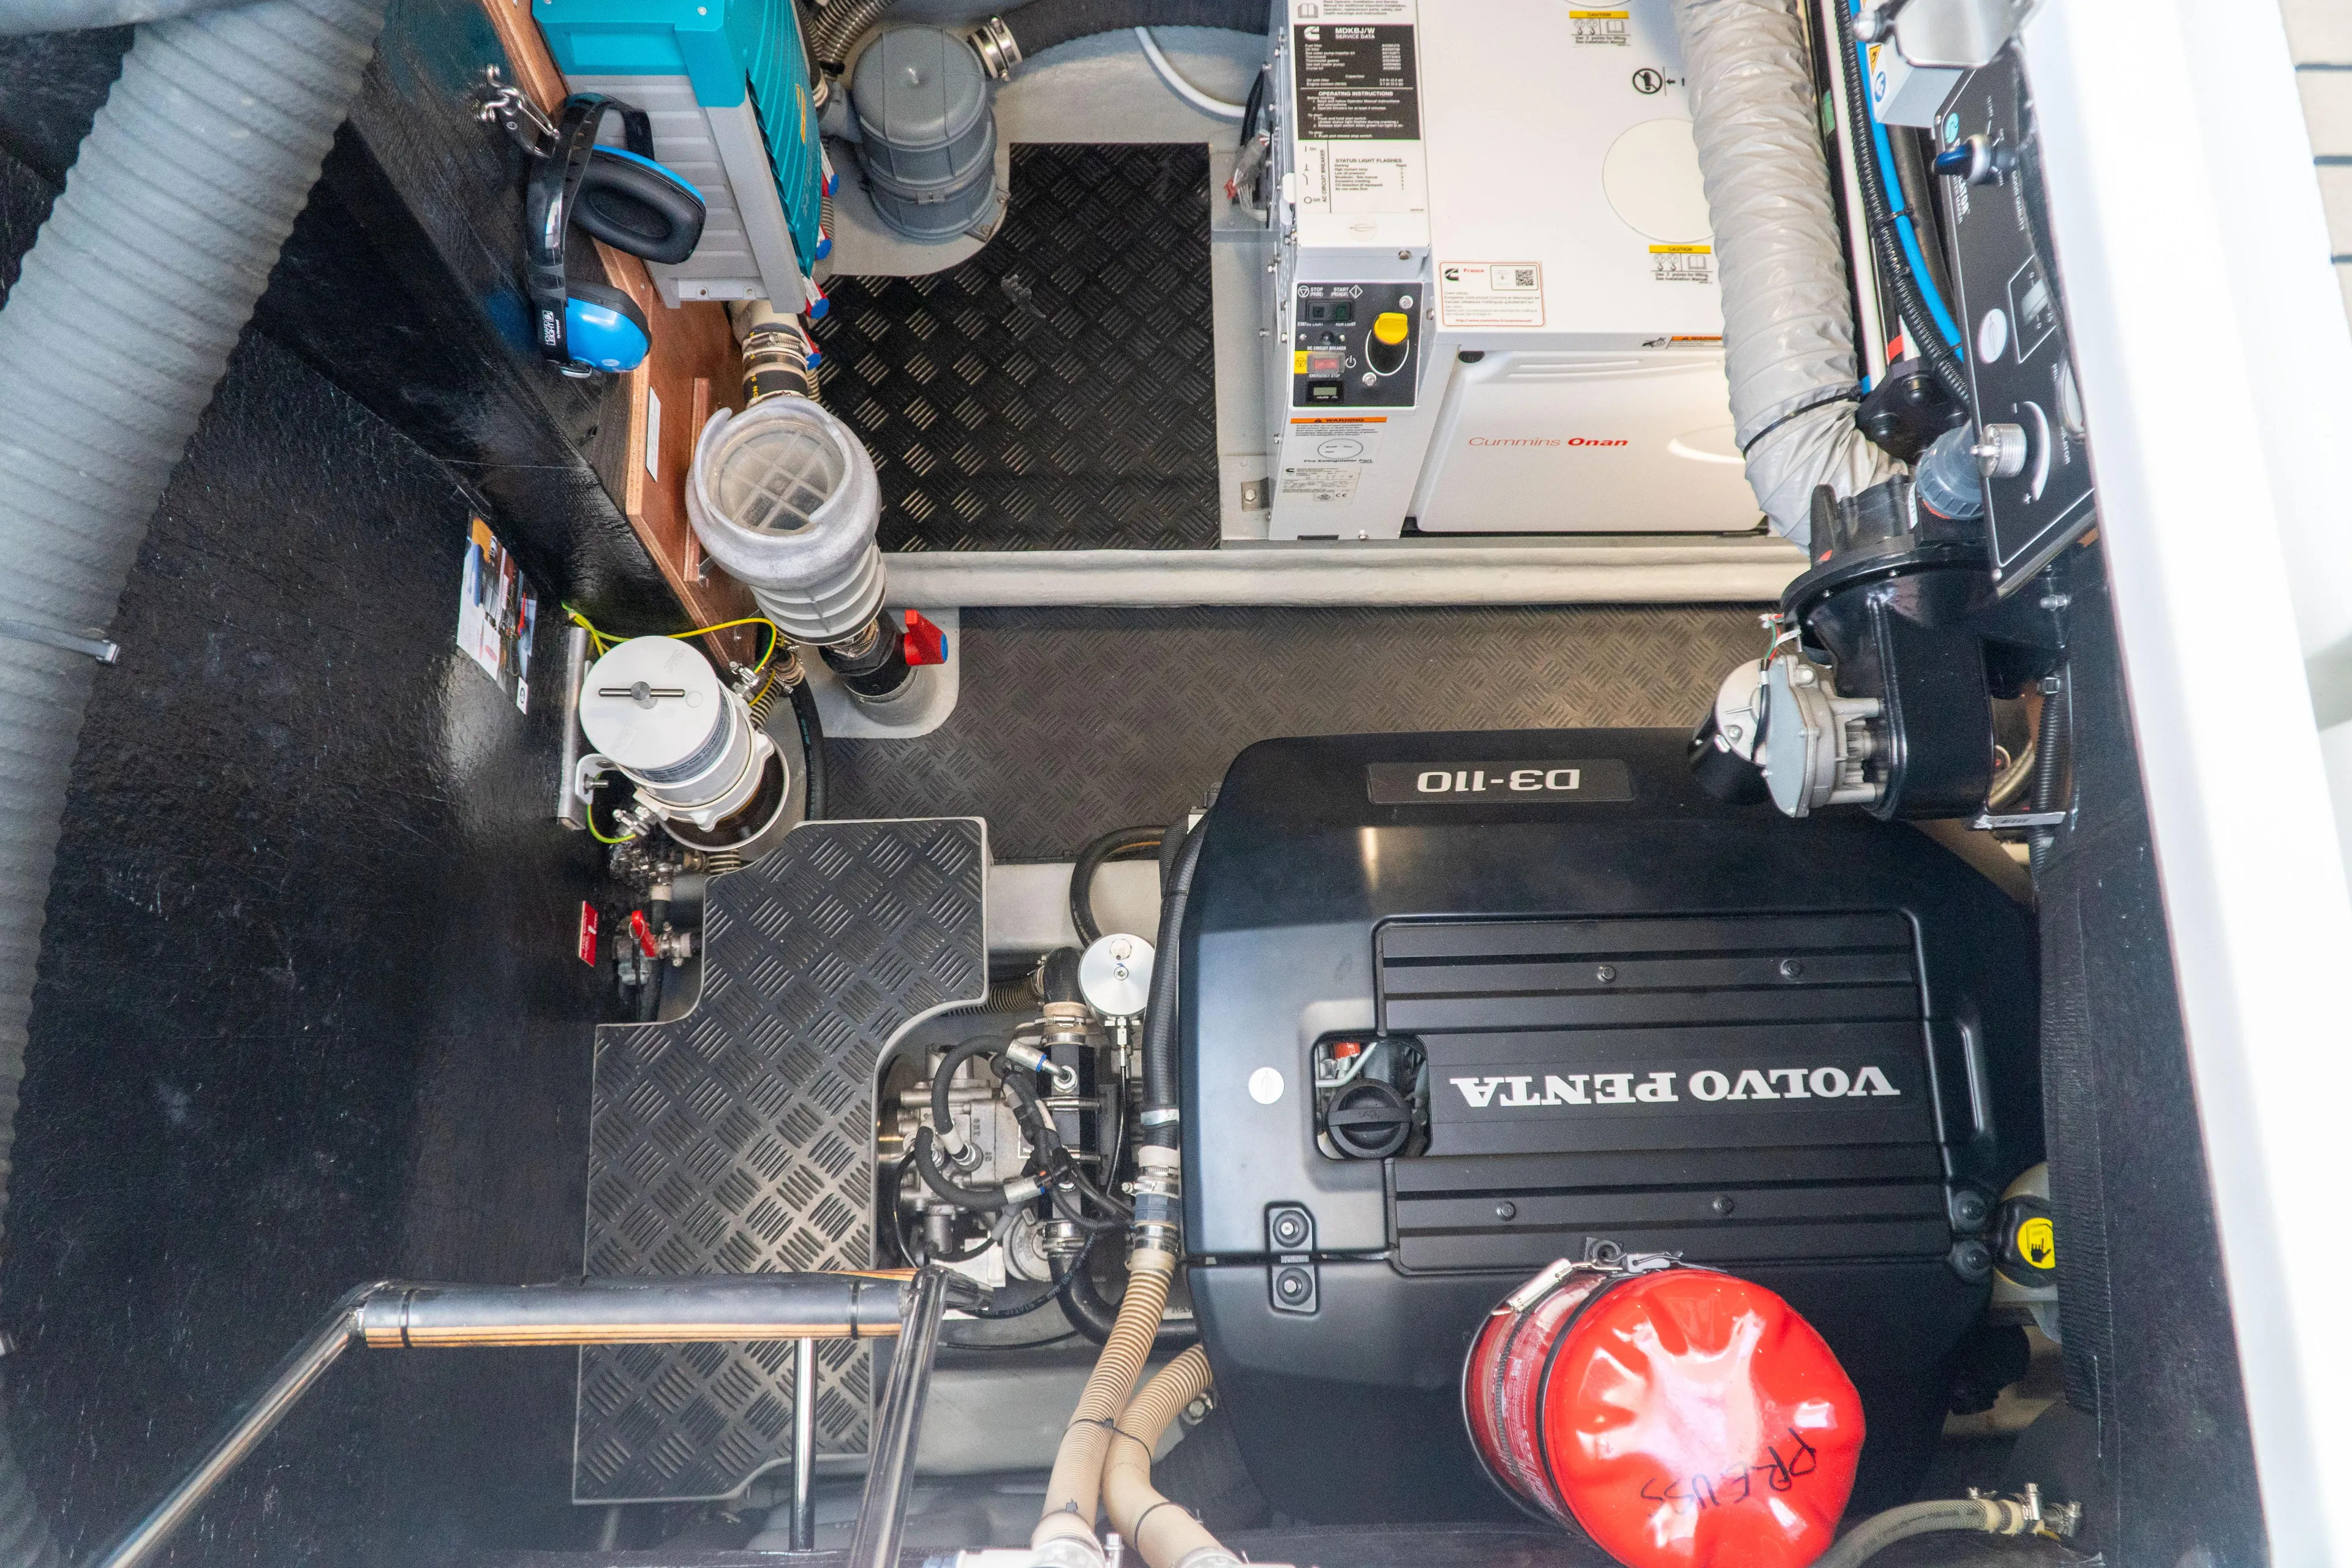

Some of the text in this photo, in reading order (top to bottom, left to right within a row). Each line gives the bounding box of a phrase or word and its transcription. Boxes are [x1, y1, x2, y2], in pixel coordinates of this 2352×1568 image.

[548, 323, 556, 346] LEIGHT
[1469, 437, 1629, 446] Cummins Onan
[1417, 769, 1580, 793] D3-110
[1450, 1066, 1901, 1107] VOLVO PENTA
